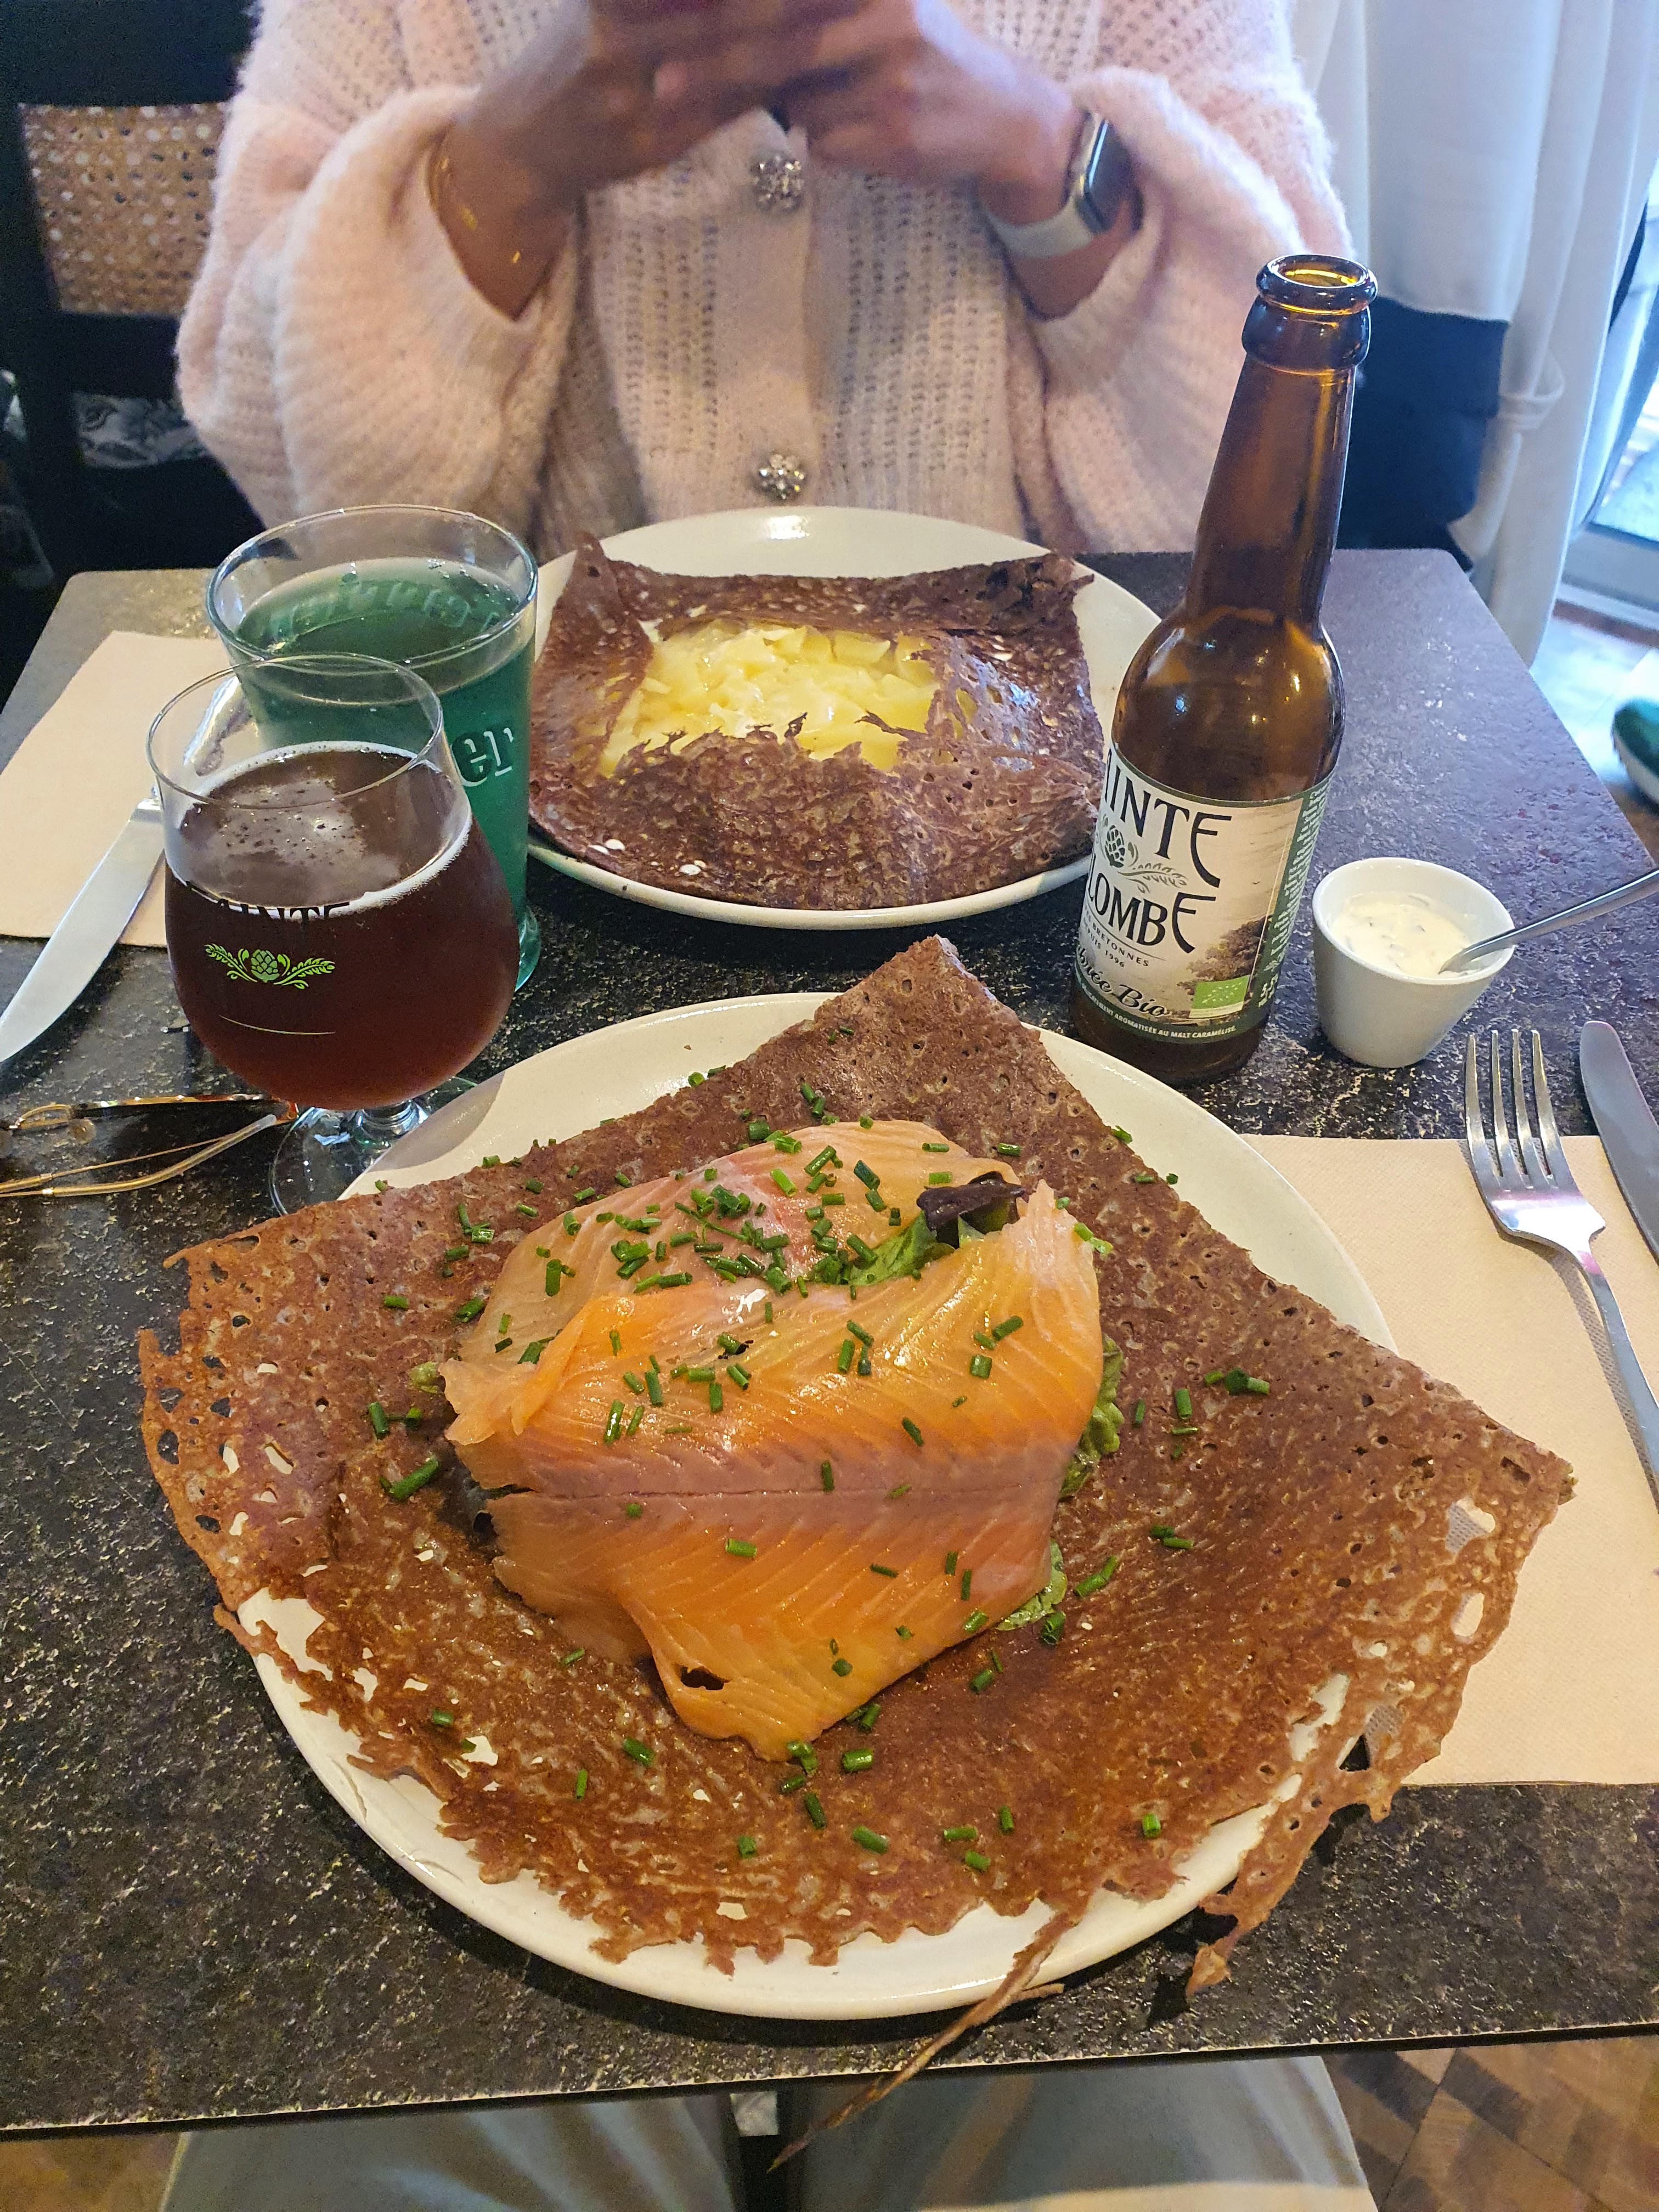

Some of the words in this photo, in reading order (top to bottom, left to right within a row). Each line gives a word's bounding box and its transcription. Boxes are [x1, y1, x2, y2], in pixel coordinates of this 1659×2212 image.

[1092, 922, 1149, 967] BRETONNES
[1104, 950, 1125, 968] 1996
[1116, 984, 1170, 1017] Bio
